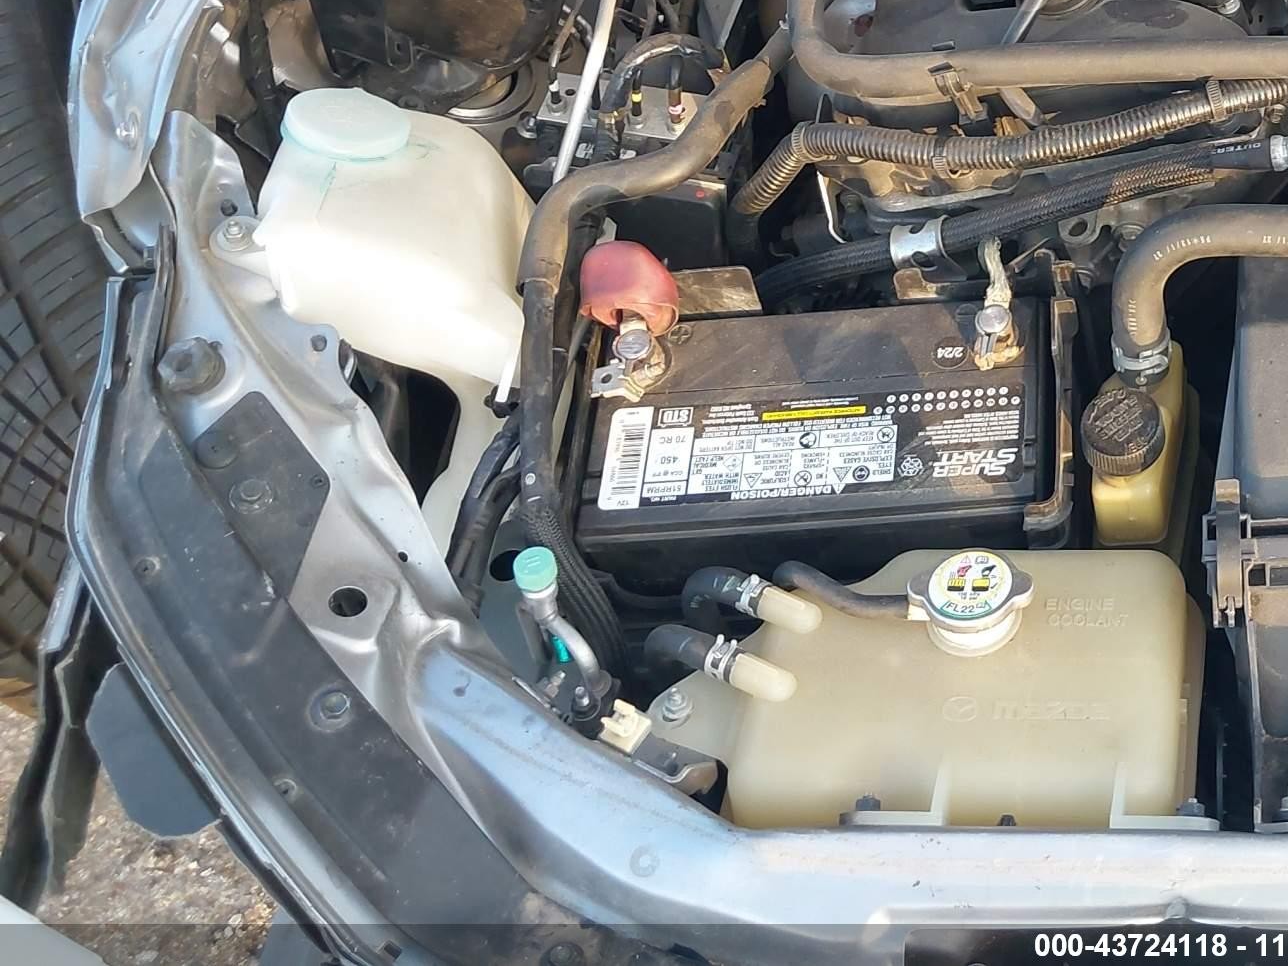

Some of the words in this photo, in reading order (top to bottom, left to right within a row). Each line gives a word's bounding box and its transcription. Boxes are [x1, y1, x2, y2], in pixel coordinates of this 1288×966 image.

[936, 346, 964, 359] 2/24
[660, 436, 673, 445] RC
[675, 435, 686, 443] 70
[660, 456, 679, 465] 450
[938, 447, 1019, 463] START
[932, 462, 1007, 478] SUPER
[646, 484, 681, 494] 51RPRM
[731, 485, 831, 500] DANGER/POISON
[945, 601, 976, 614] FL22
[1044, 597, 1115, 612] ENGINE
[1047, 613, 1129, 627] COOLANT
